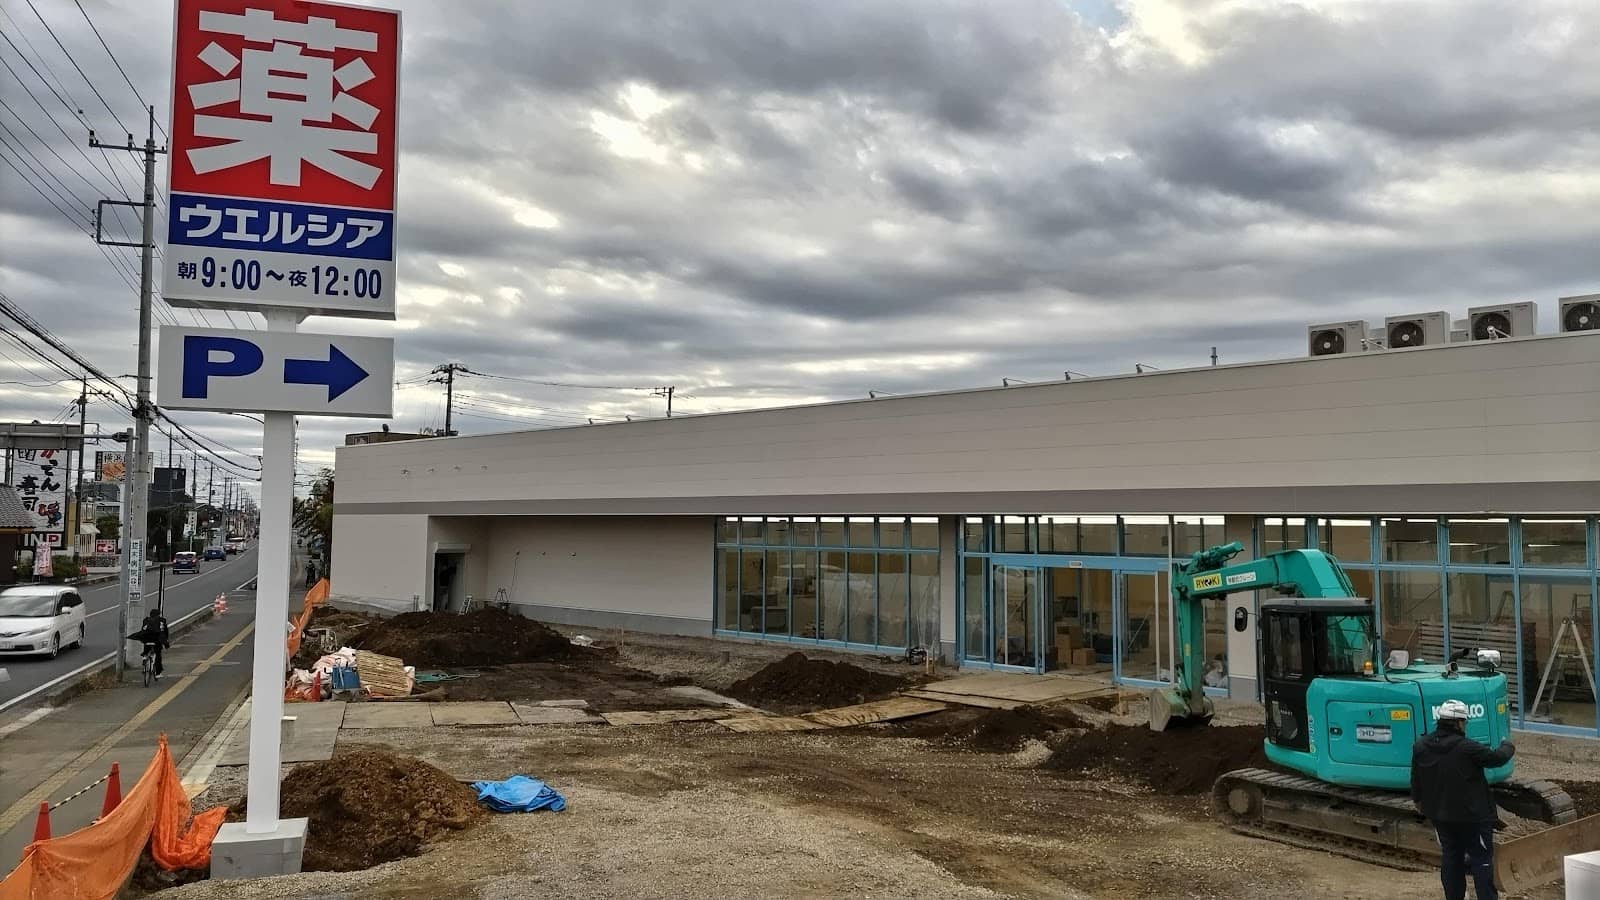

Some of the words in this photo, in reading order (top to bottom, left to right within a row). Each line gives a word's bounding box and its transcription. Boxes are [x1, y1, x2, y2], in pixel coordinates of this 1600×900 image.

[186, 6, 384, 191] 薬
[179, 203, 384, 249] ウエルシア
[182, 336, 264, 399] P
[1432, 703, 1485, 720] KLCO
